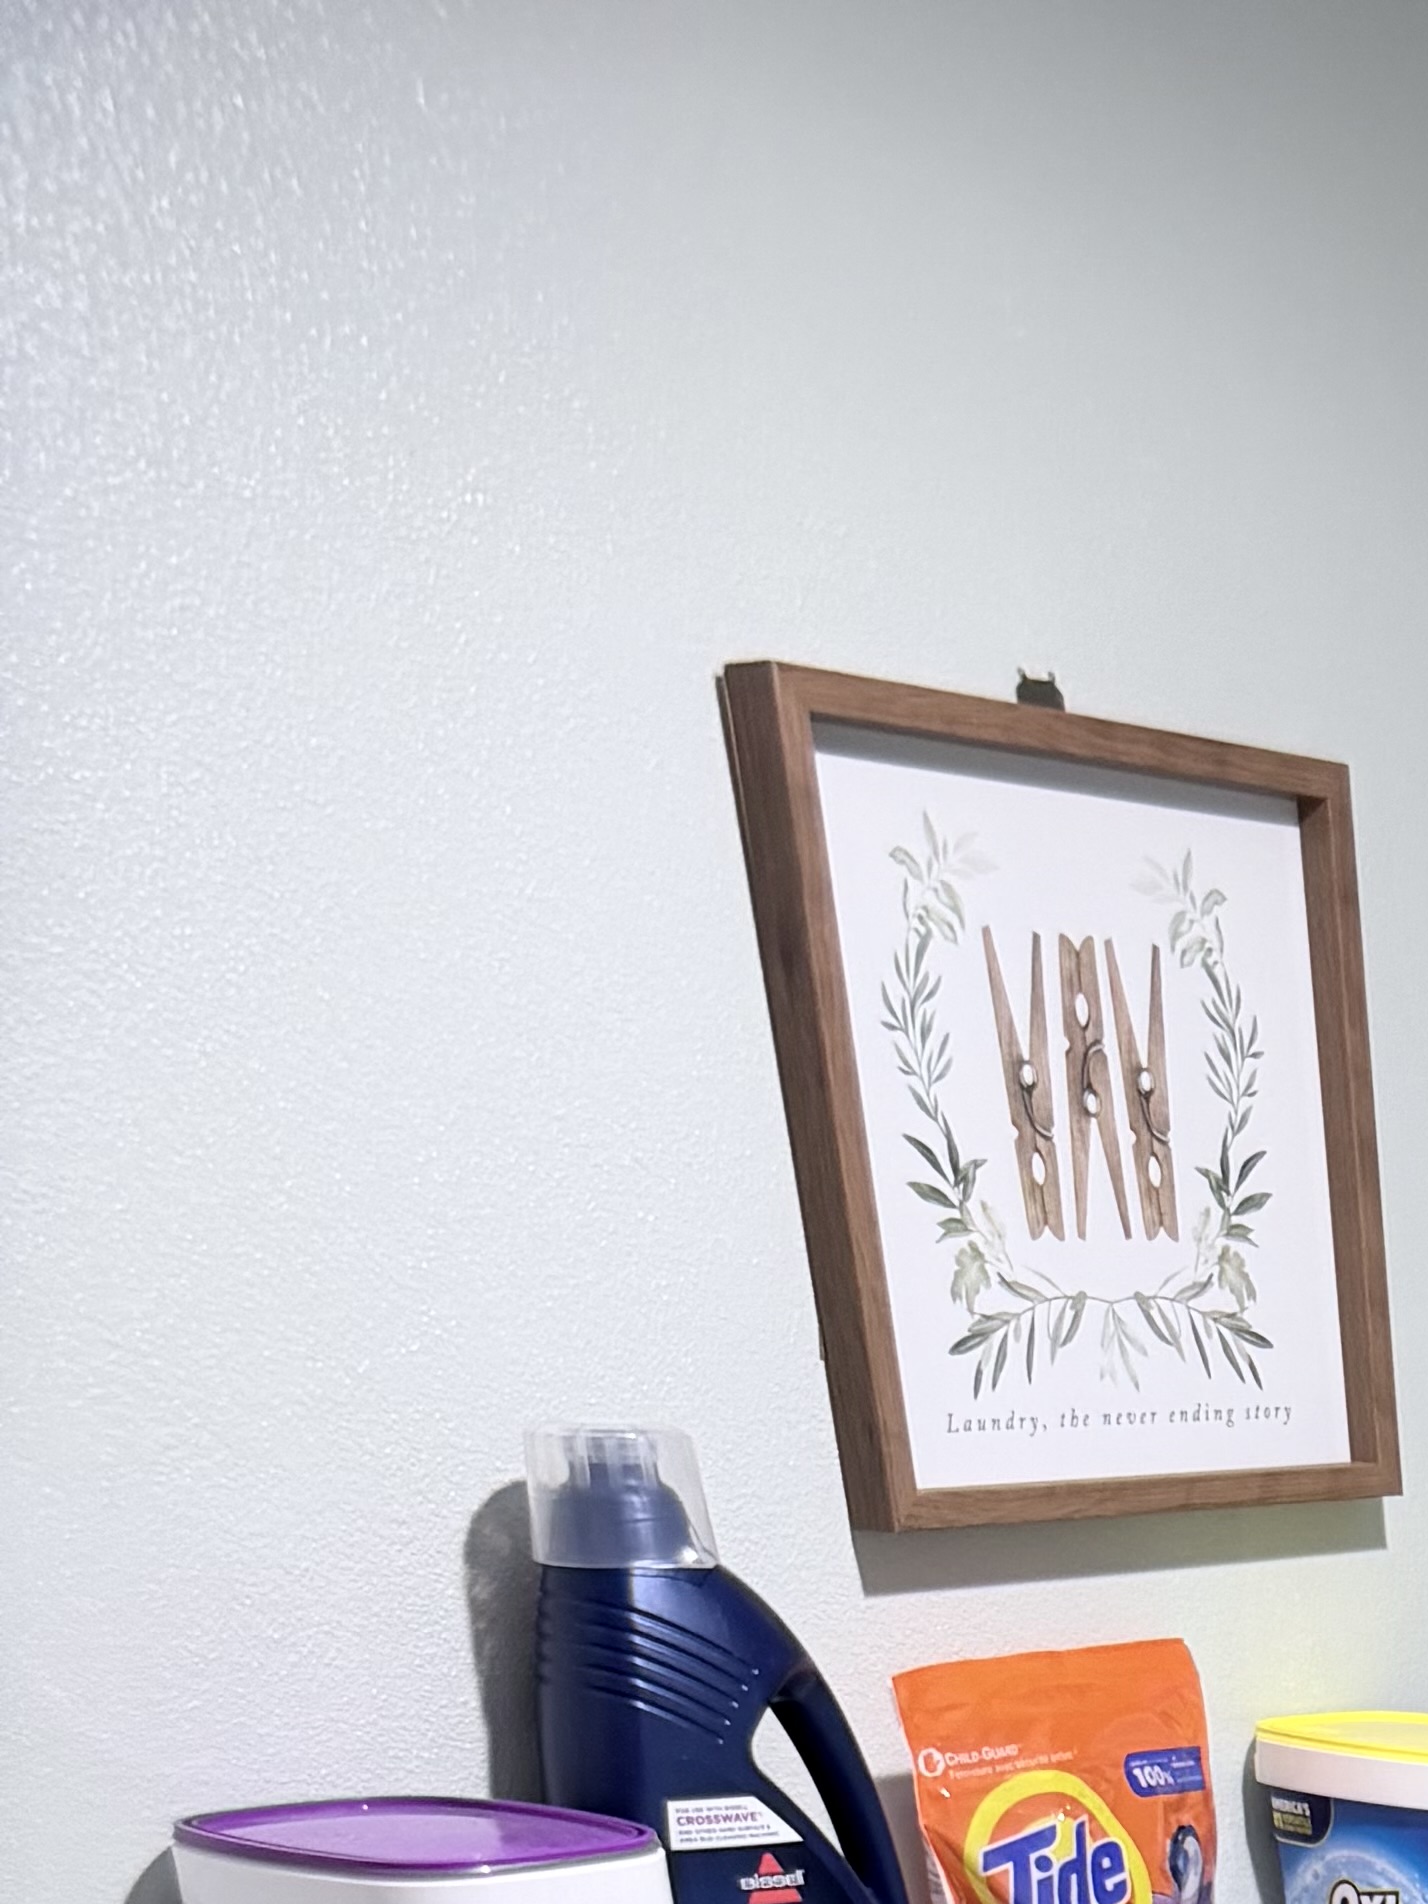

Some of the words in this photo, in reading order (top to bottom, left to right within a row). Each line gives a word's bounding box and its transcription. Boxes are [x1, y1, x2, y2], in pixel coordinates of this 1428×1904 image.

[946, 1411, 1048, 1438] Laundry,
[1059, 1409, 1091, 1428] the
[1102, 1409, 1158, 1426] never
[1168, 1404, 1236, 1428] ending
[1244, 1402, 1294, 1425] story
[676, 1811, 759, 1827] CROSSWAVE
